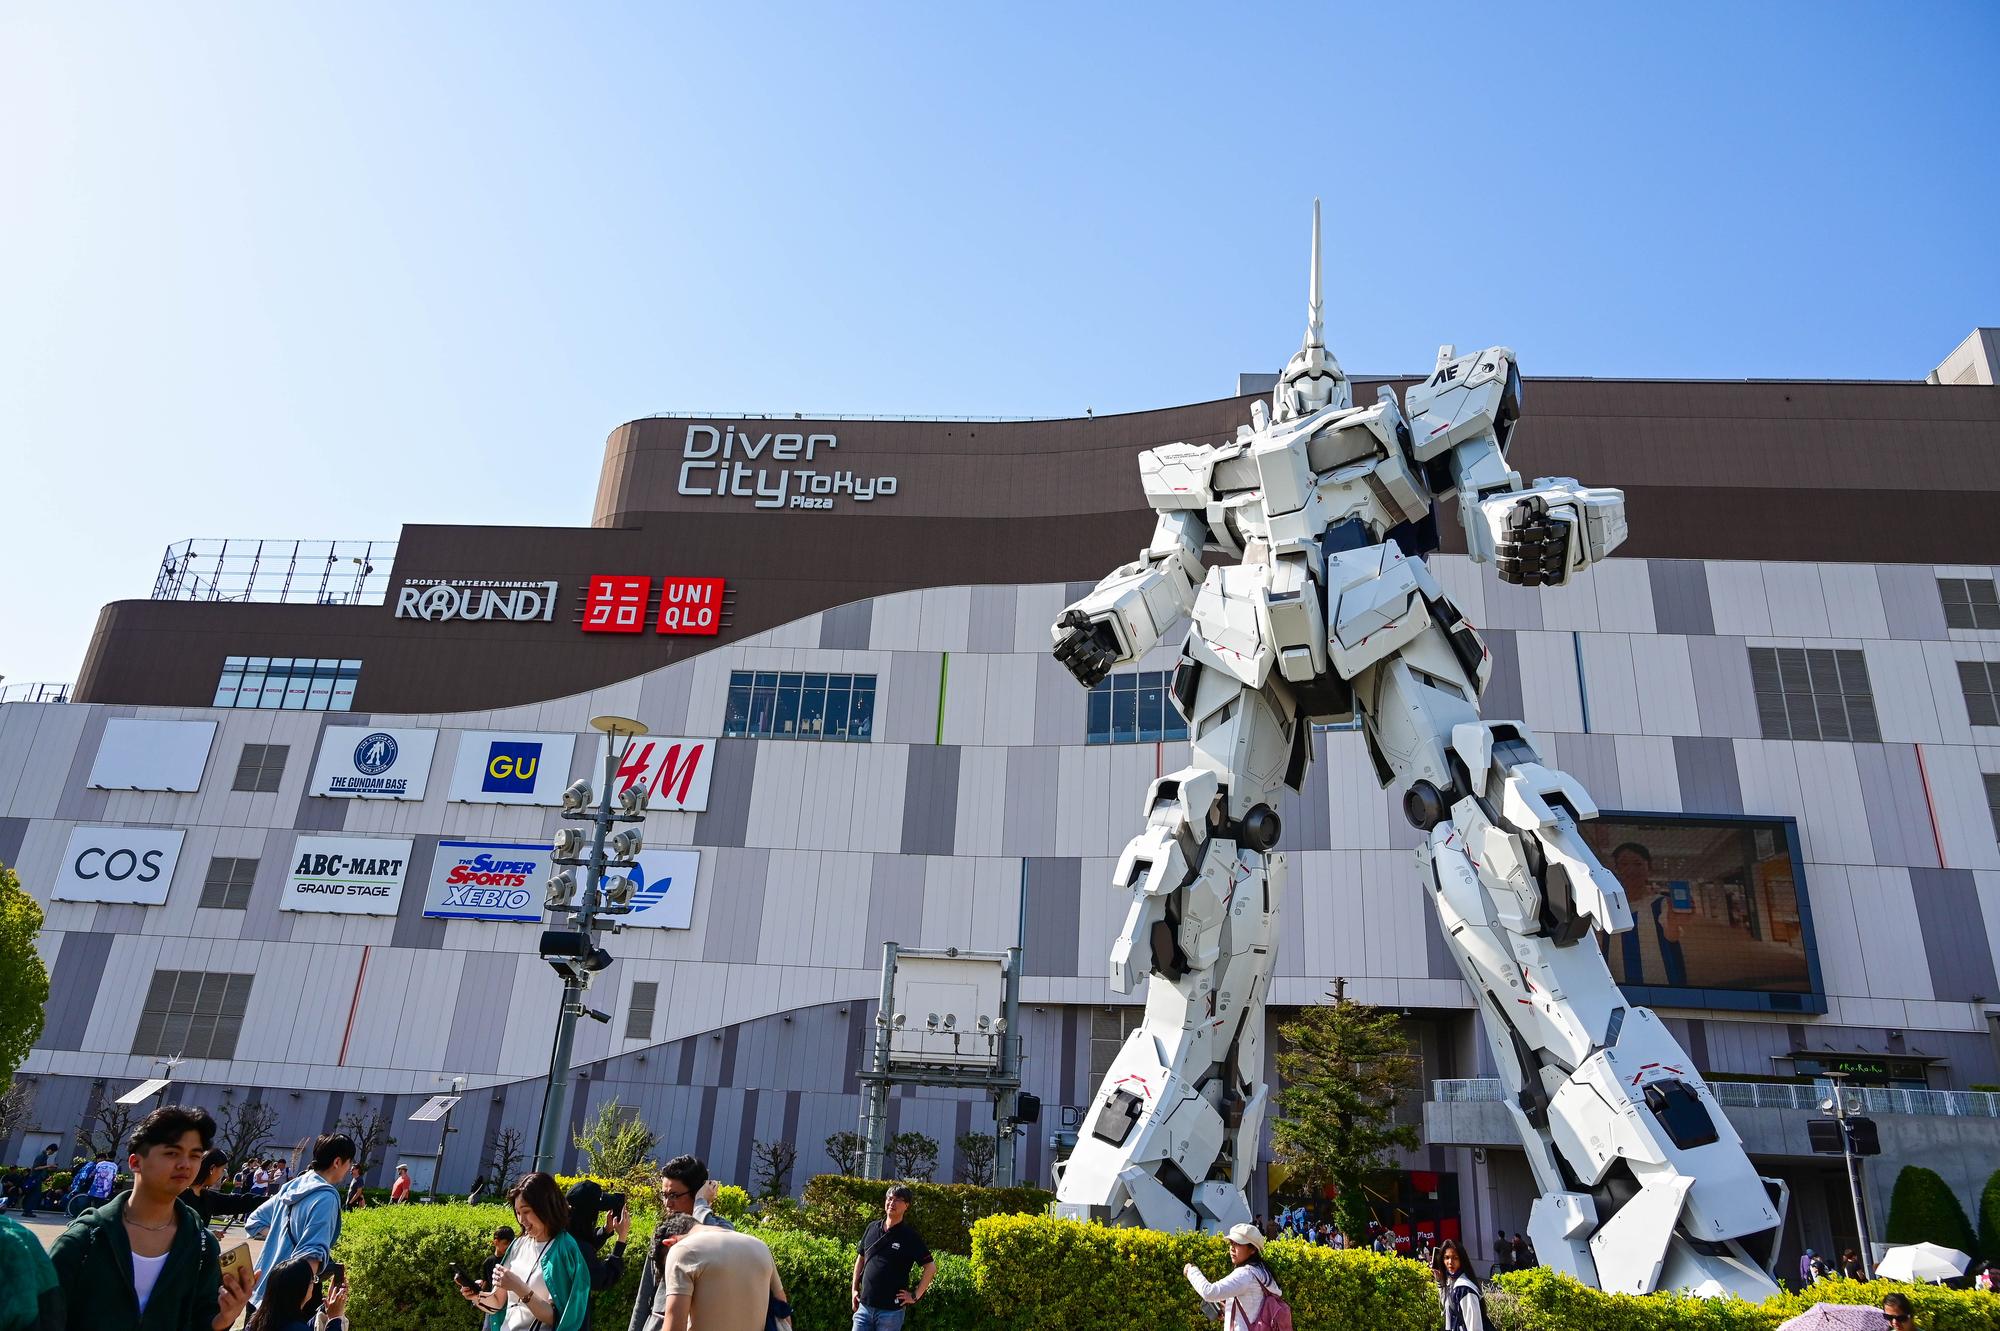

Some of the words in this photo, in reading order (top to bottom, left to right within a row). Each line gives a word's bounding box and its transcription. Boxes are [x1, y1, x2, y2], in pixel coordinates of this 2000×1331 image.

[683, 424, 837, 460] Diver
[677, 461, 789, 508] City
[793, 470, 897, 500] Tokyo
[790, 495, 833, 509] Plaza
[405, 578, 447, 586] SPORTS
[452, 580, 543, 588] ENTERTAINMENT
[668, 583, 712, 604] UNI
[394, 581, 559, 622] ROUND1
[664, 606, 713, 630] QLO
[489, 755, 537, 780] GU
[331, 776, 347, 787] THE
[347, 777, 384, 789] GUNDAM
[385, 779, 408, 790] BASE
[75, 847, 164, 882] COS
[295, 853, 402, 876] ABC-MART
[470, 853, 537, 874] SUPER
[446, 865, 527, 887] SPORTS
[296, 883, 345, 895] GRAND
[346, 886, 391, 897] STAGE
[441, 885, 531, 909] XEBIO
[1395, 1235, 1410, 1243] okyo
